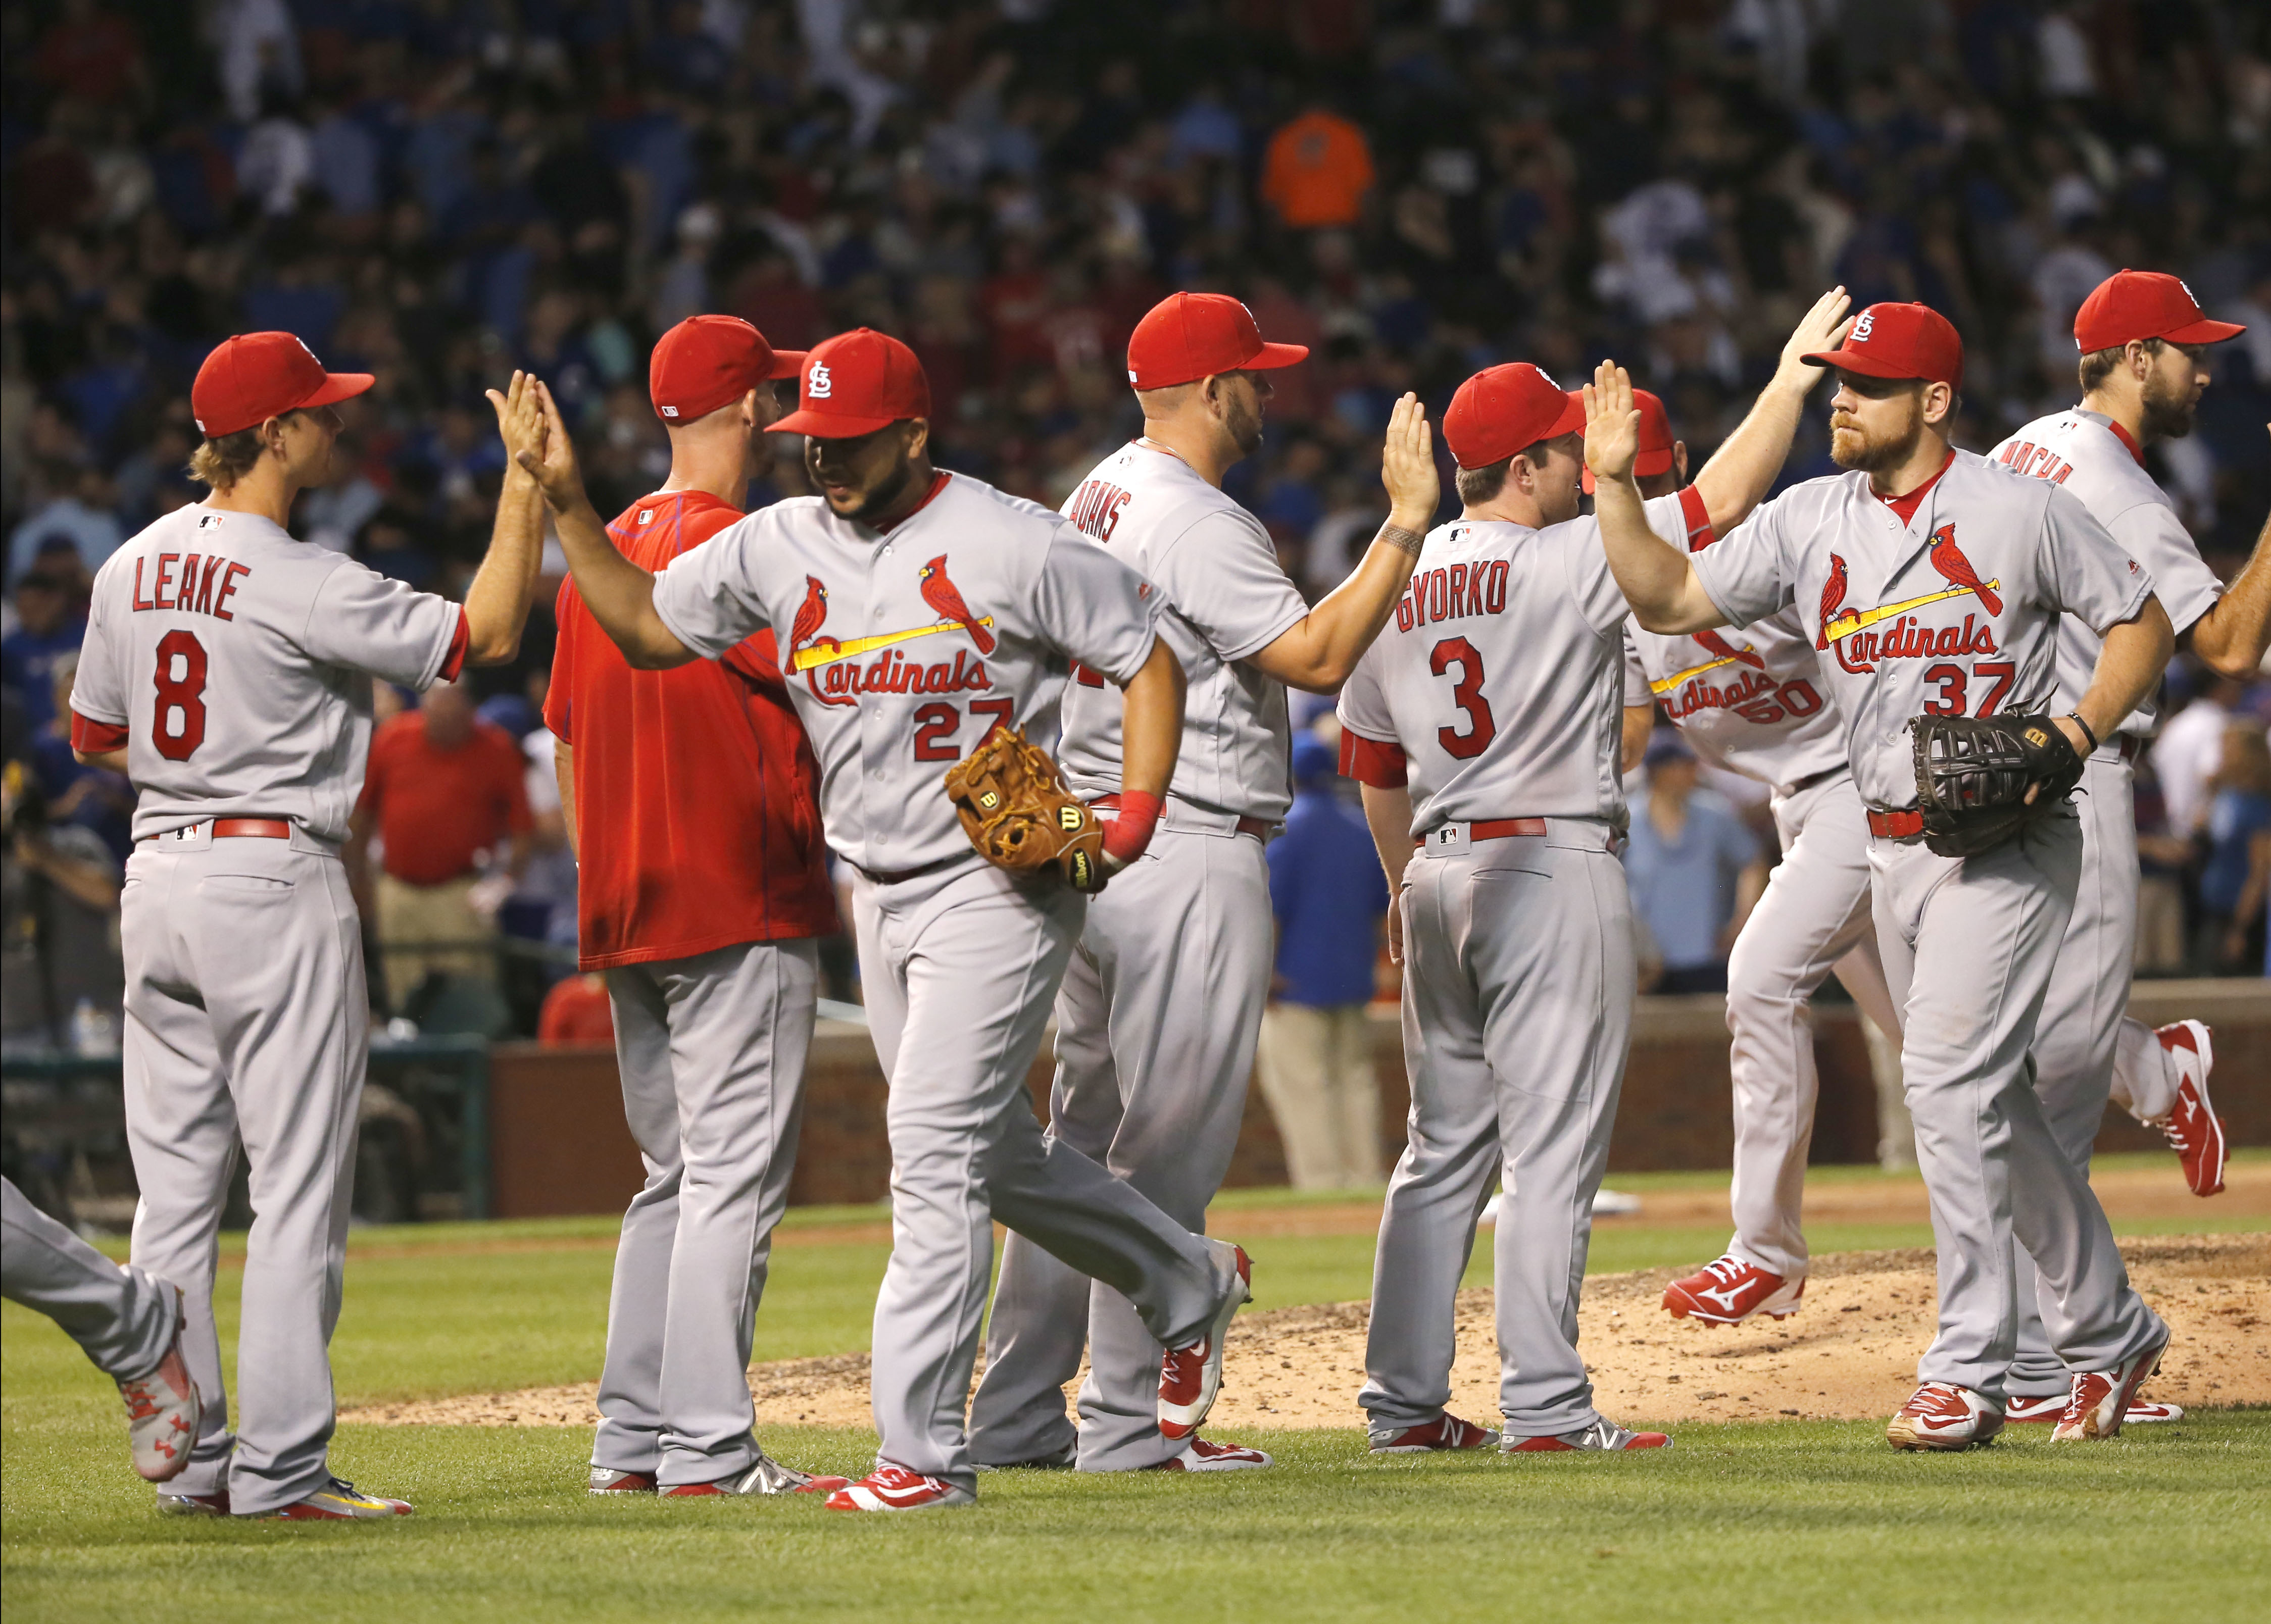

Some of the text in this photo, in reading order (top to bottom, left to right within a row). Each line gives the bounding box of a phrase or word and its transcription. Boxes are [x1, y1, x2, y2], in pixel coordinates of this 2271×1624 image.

[1069, 480, 1131, 543] ADAMS
[133, 553, 252, 622] LEAKE
[1396, 560, 1510, 633] GYORKO
[807, 636, 994, 707] Cardinals
[1834, 607, 1998, 674] Cardinals
[152, 629, 208, 763] 8
[1429, 635, 1497, 760] 3
[1733, 678, 1822, 724] 50
[1923, 661, 2015, 719] 37
[914, 697, 1014, 762] 27
